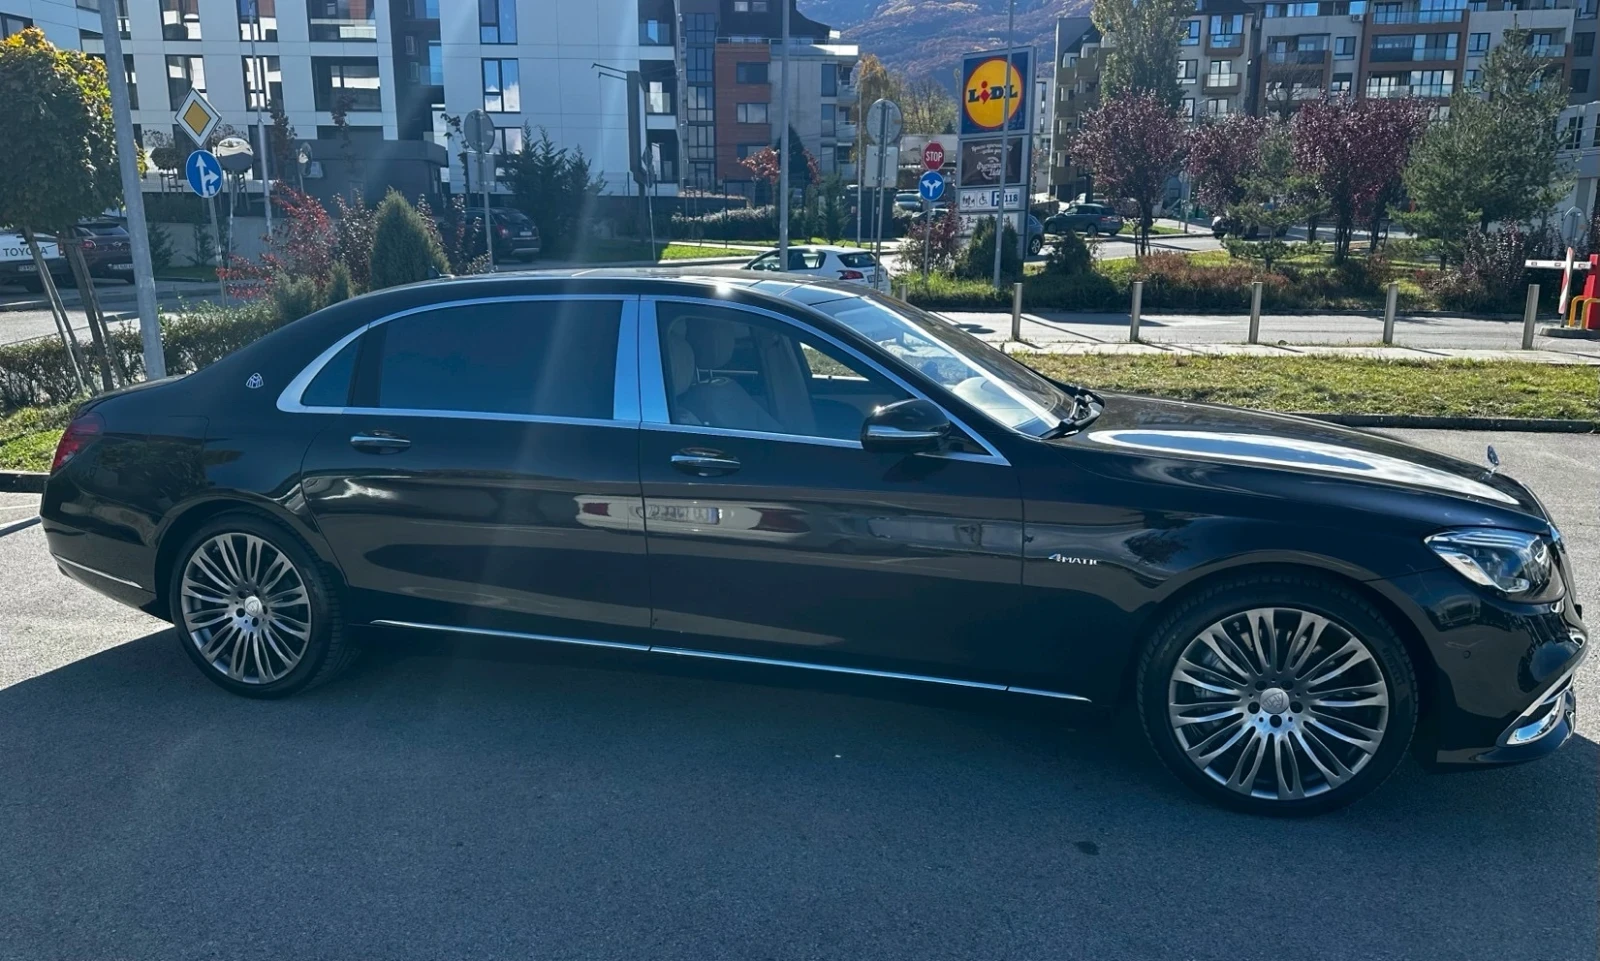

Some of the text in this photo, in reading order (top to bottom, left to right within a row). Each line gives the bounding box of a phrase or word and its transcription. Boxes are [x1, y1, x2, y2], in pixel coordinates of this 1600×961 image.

[925, 151, 943, 162] STOP
[1005, 194, 1018, 202] 118
[3, 247, 48, 257] TOYOA
[1048, 553, 1098, 565] 4MATIC
